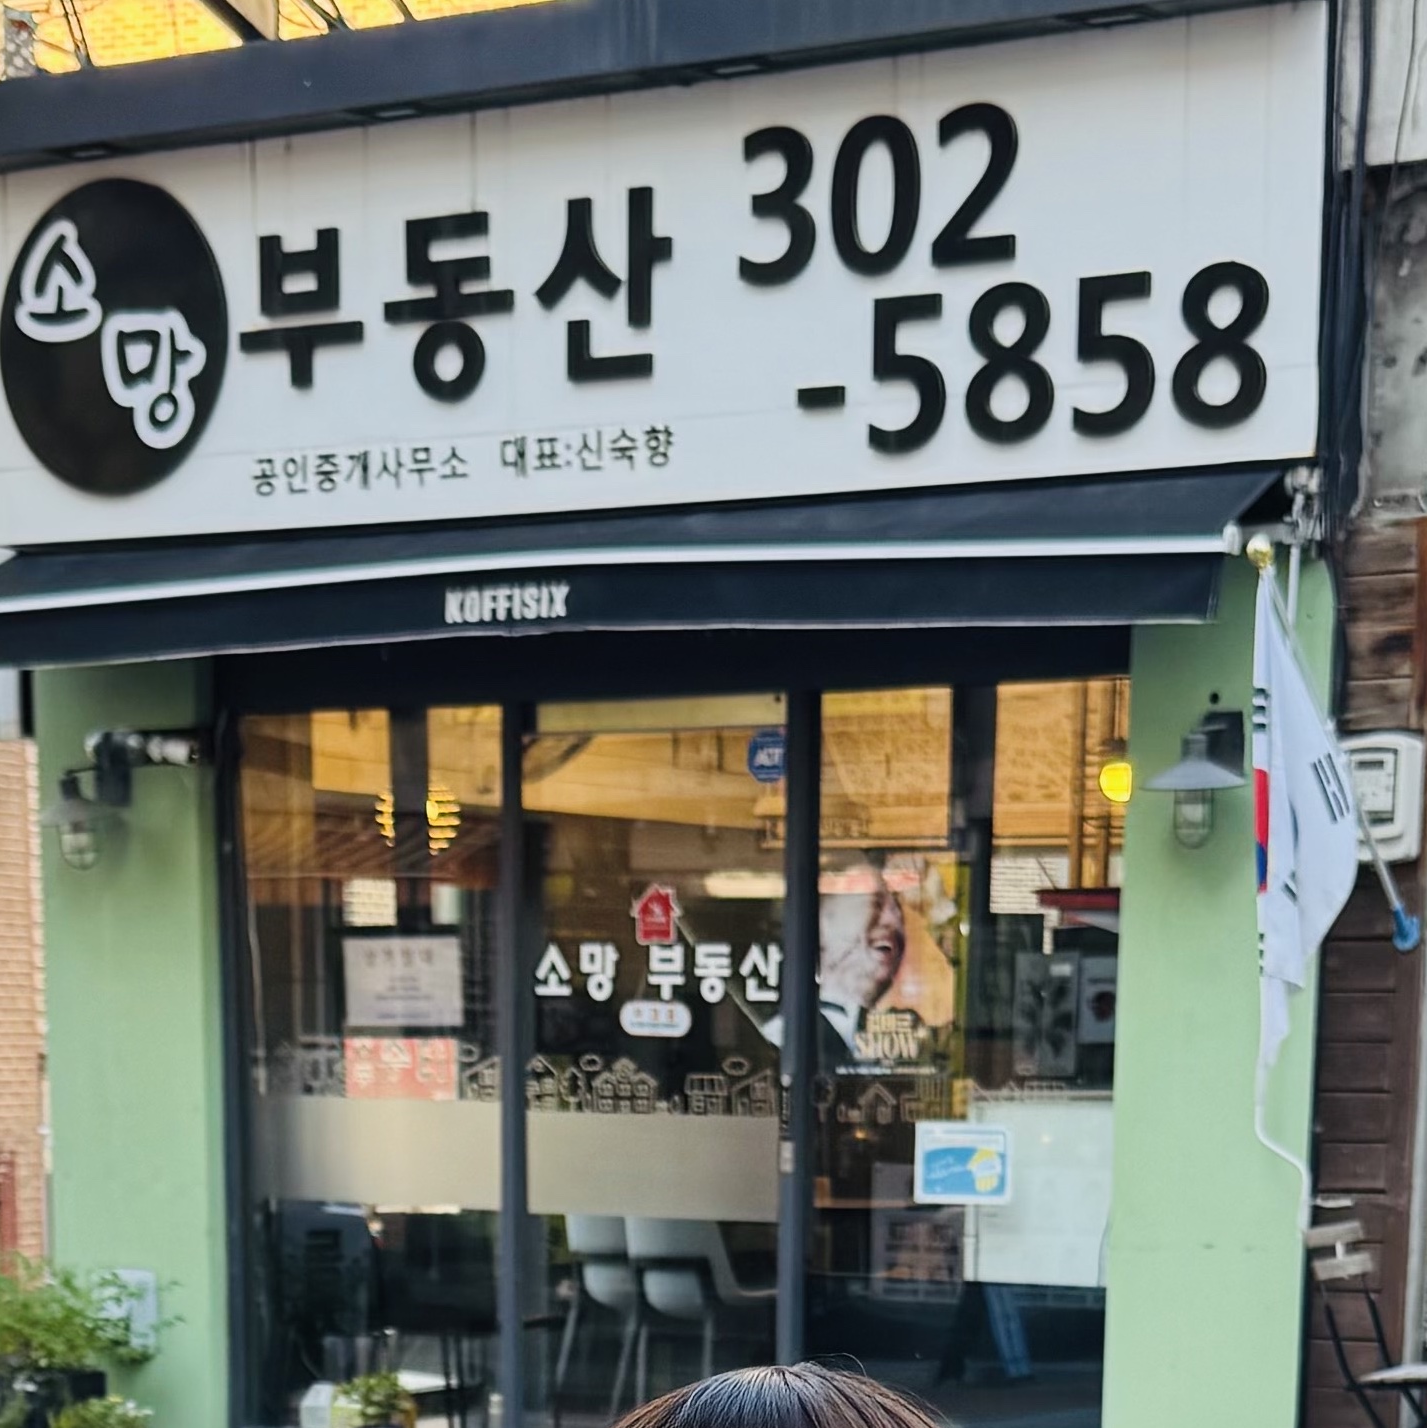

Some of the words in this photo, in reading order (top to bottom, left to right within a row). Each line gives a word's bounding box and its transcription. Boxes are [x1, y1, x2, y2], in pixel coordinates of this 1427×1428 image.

[738, 102, 1022, 288] 302
[15, 216, 208, 452] 소망
[239, 186, 674, 402] 부동산
[795, 260, 1272, 455] -5858
[251, 445, 469, 497] 공인중개사무소
[500, 424, 675, 477] 대표:신숙향
[444, 582, 570, 624] KOFFISIX
[534, 941, 620, 1001] 소망
[647, 941, 783, 1003] 부동산
